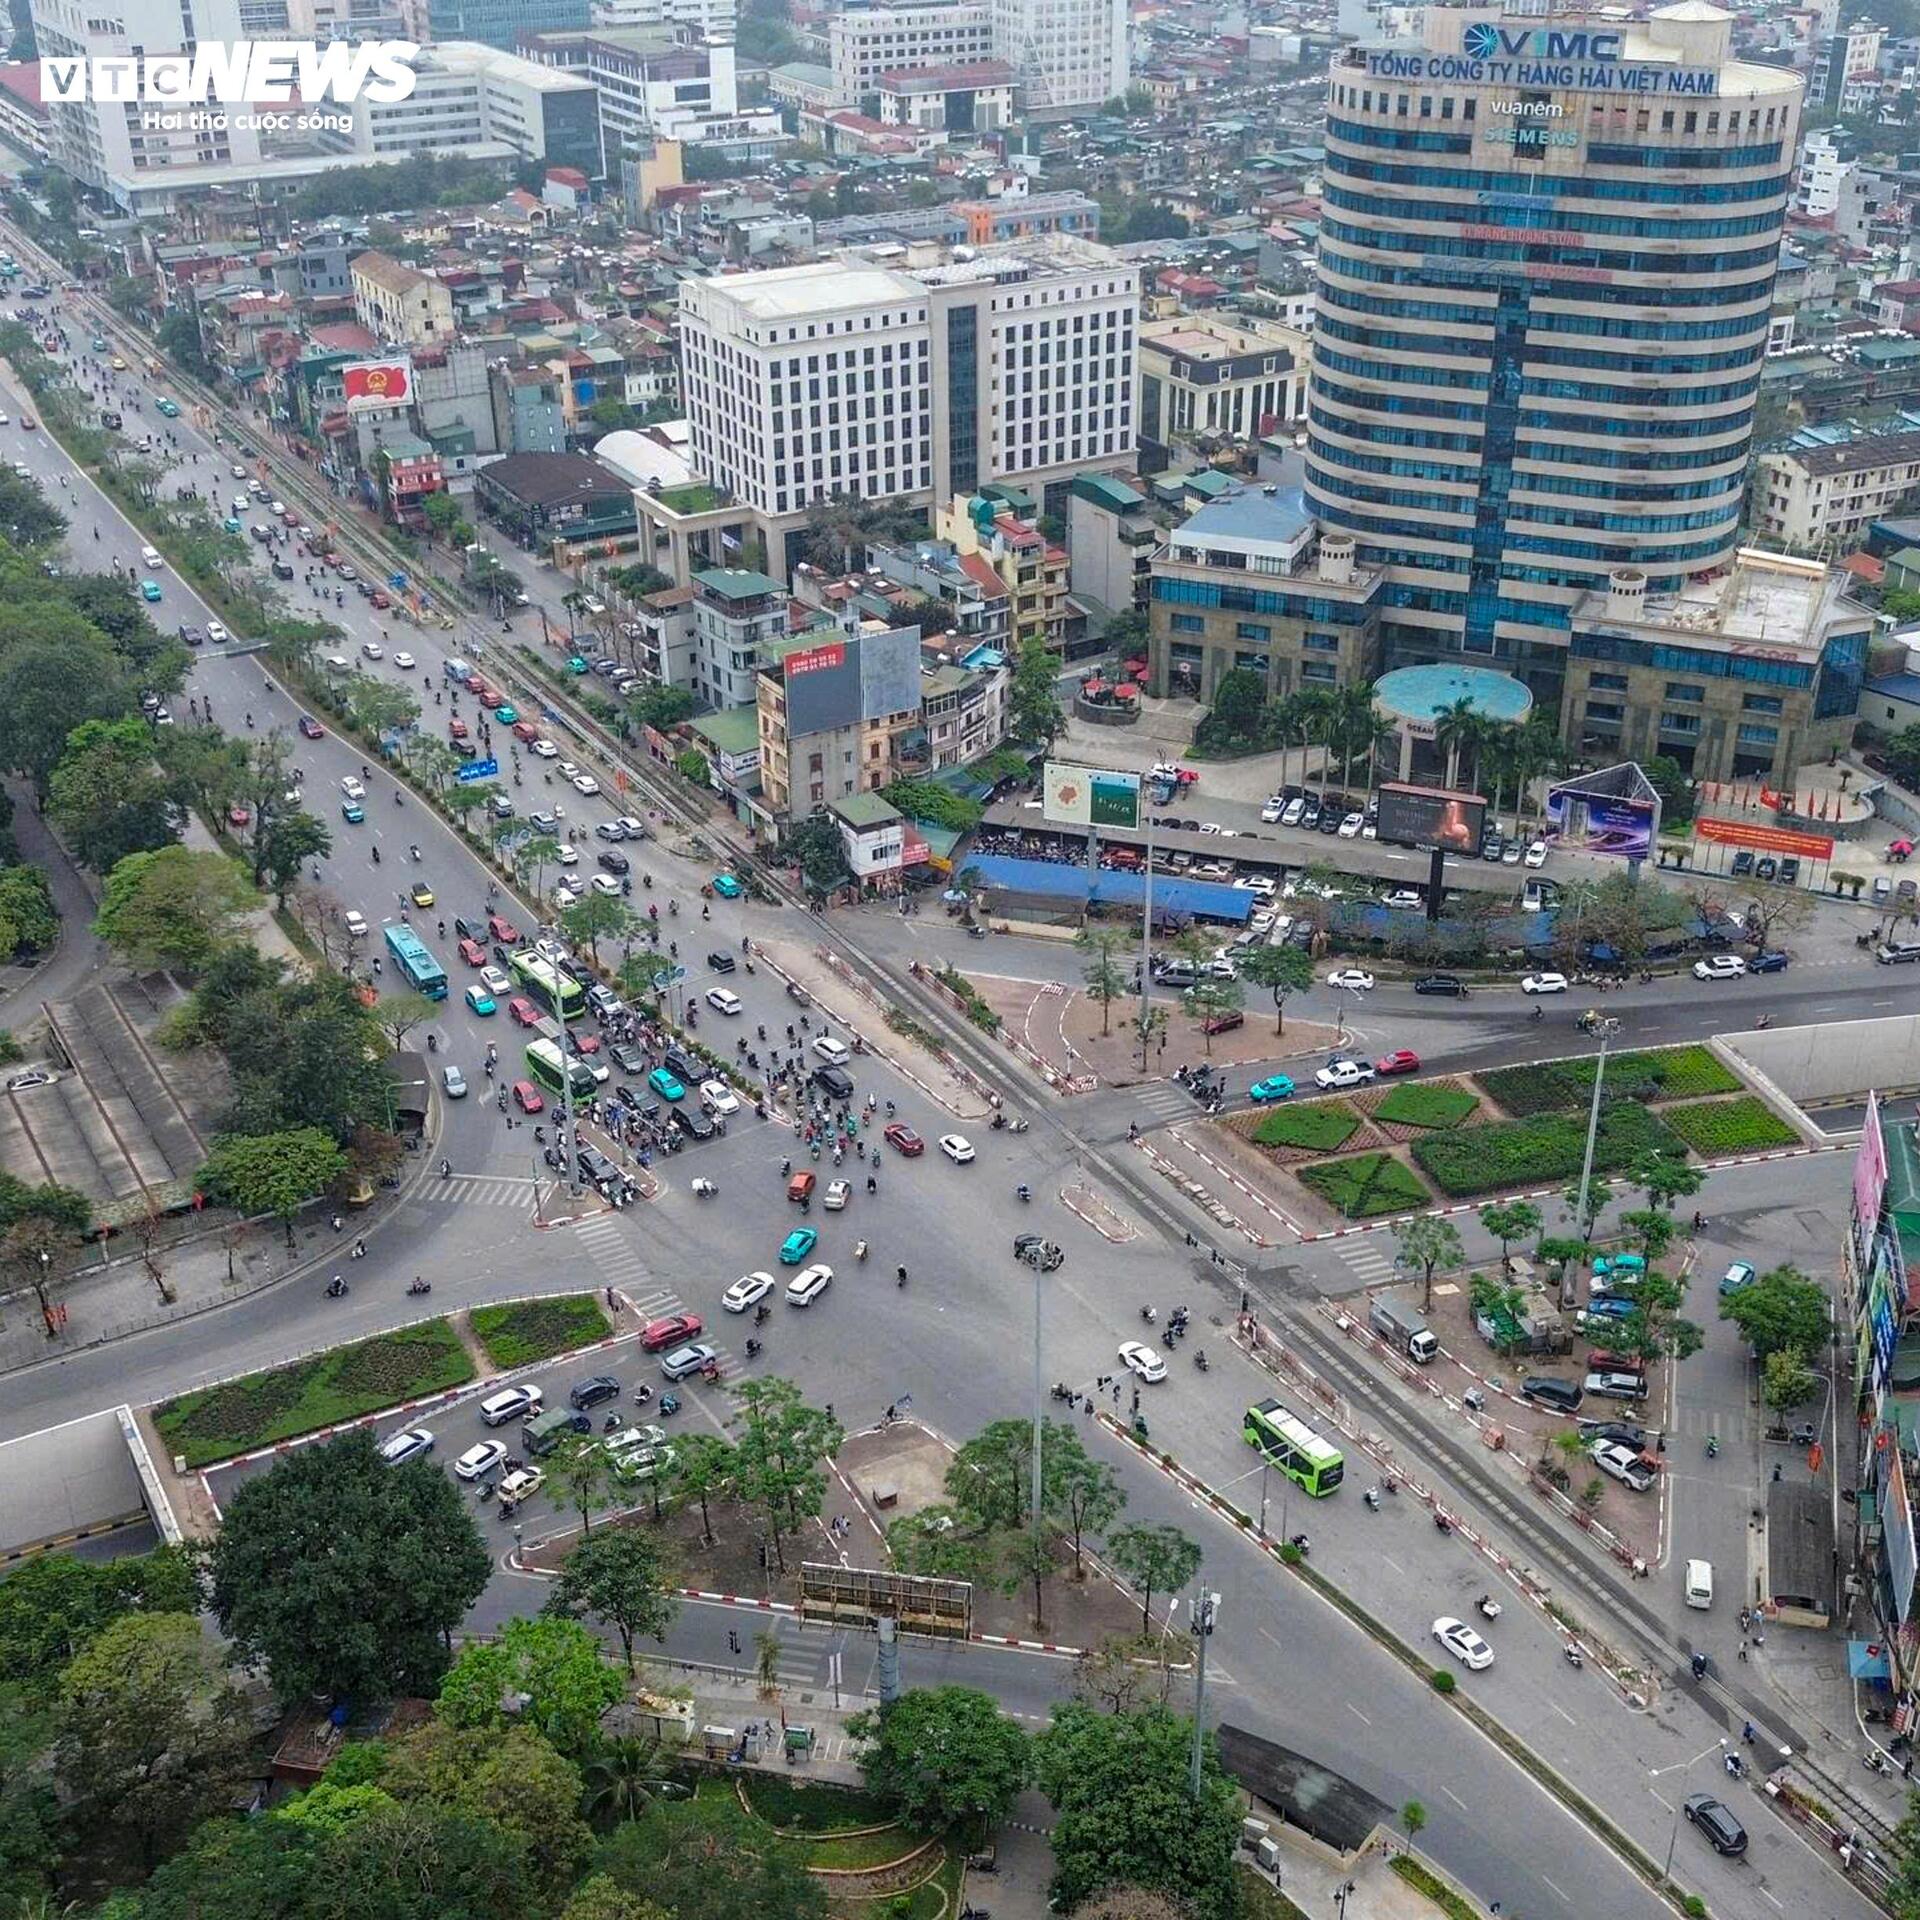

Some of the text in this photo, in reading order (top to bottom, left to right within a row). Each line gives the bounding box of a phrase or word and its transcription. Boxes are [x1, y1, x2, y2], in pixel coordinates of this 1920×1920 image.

[1497, 29, 1619, 62] VIMC
[1370, 50, 1714, 96] TỔNG CÔNG TY HÀNG HẢI VIỆT NAM
[1483, 127, 1578, 149] SIEMENS
